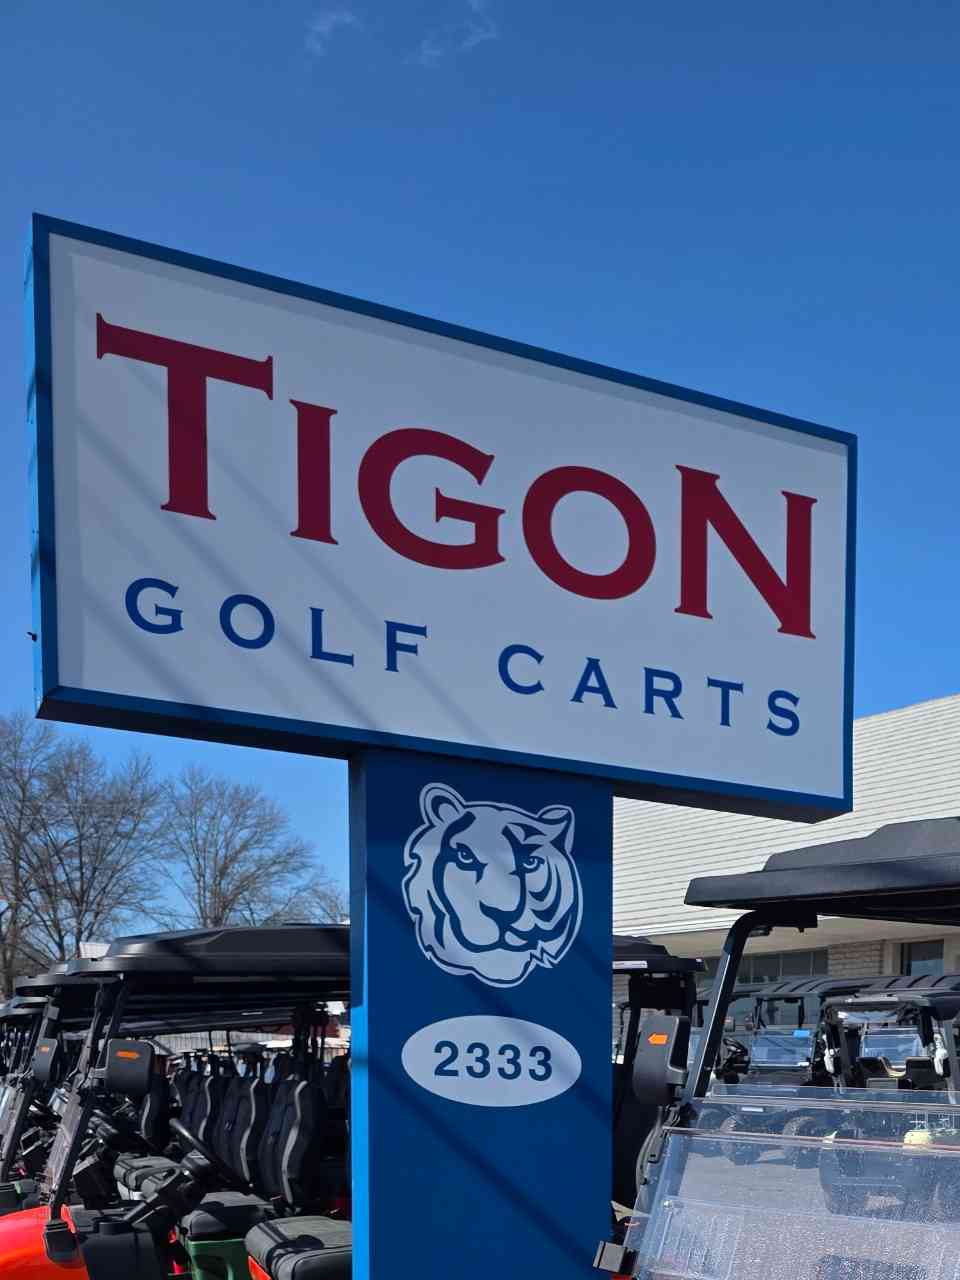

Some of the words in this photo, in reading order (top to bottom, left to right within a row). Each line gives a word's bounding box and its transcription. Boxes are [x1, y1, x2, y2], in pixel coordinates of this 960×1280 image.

[96, 313, 817, 640] TIGON
[125, 577, 428, 673] GOLF
[498, 644, 801, 738] CARTS
[433, 1040, 553, 1082] 2333
